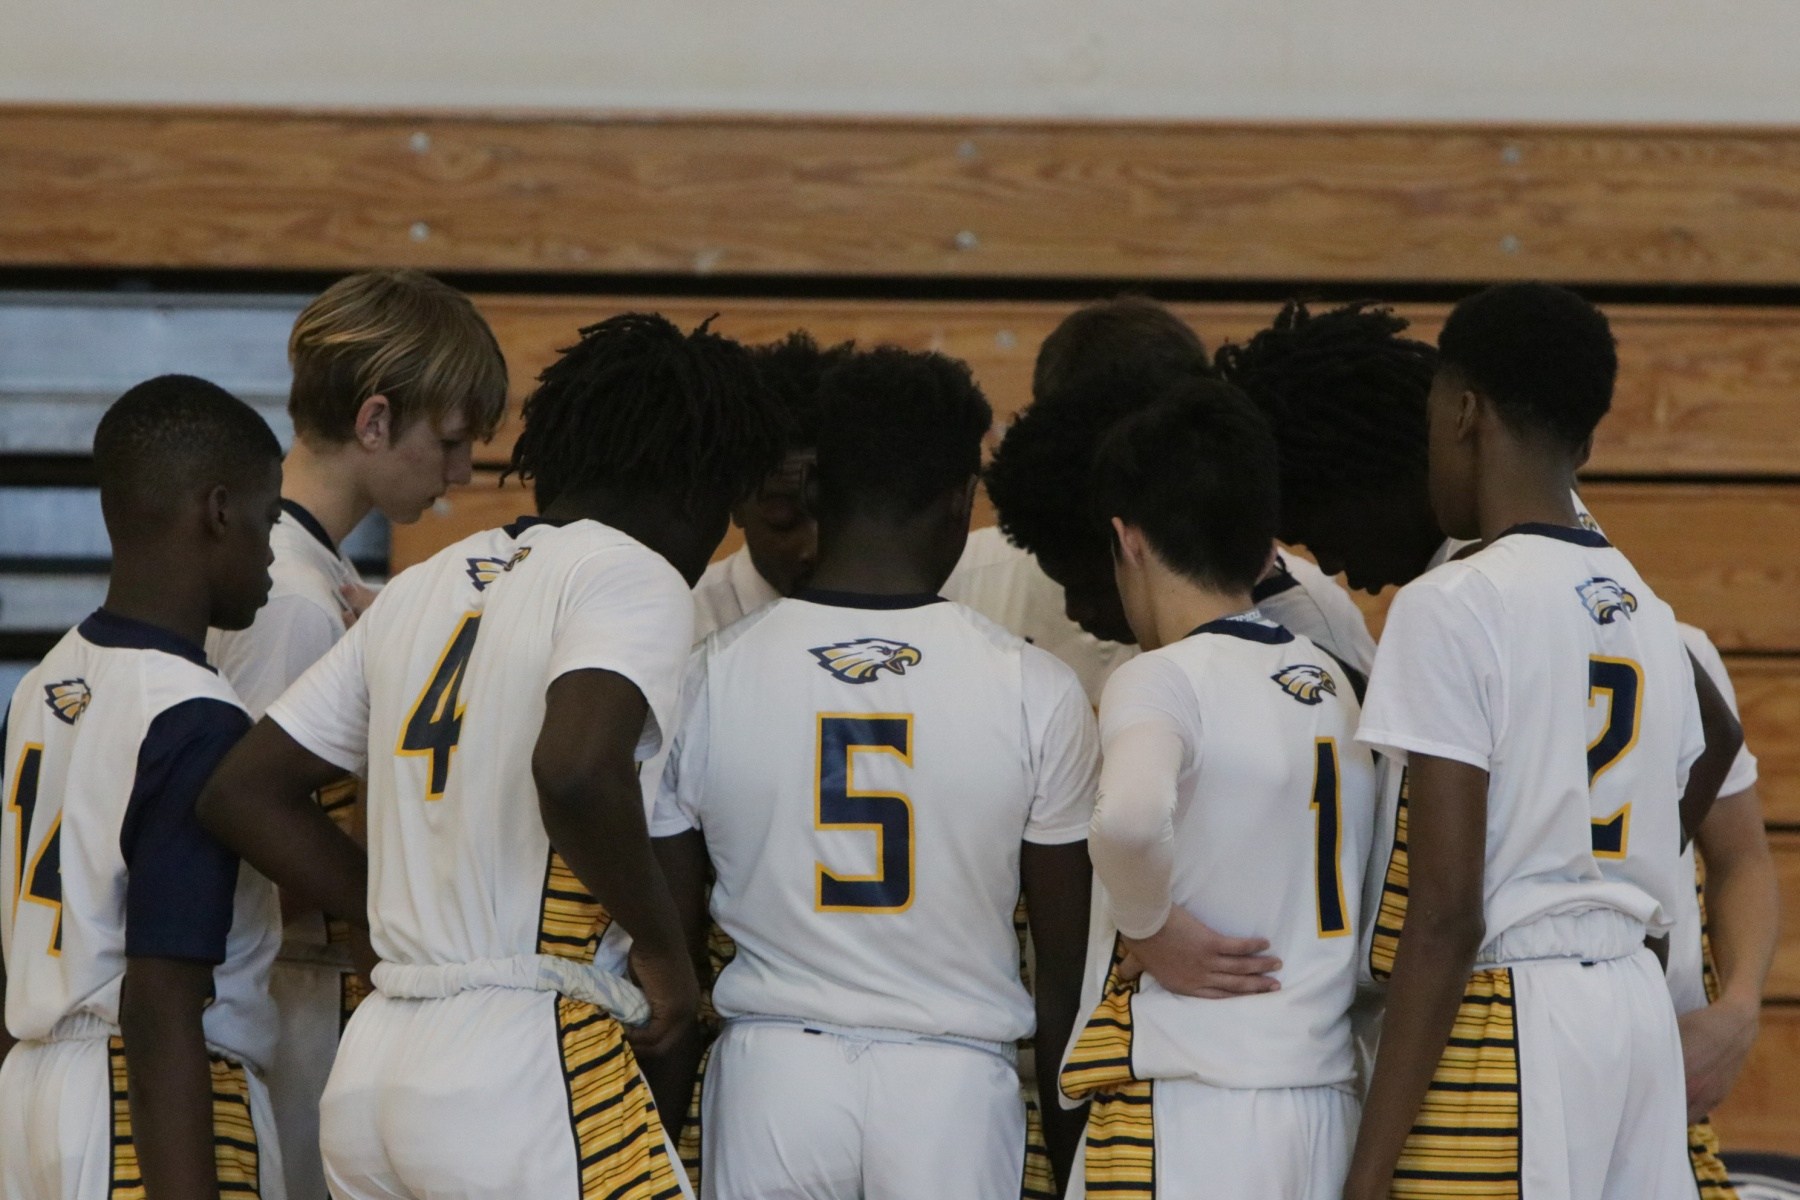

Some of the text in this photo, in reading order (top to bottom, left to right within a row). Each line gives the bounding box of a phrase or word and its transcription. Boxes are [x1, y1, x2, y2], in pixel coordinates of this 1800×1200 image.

[395, 610, 483, 801] 4
[1587, 653, 1645, 859] 2
[814, 712, 916, 914] 5
[1309, 736, 1352, 938] 1
